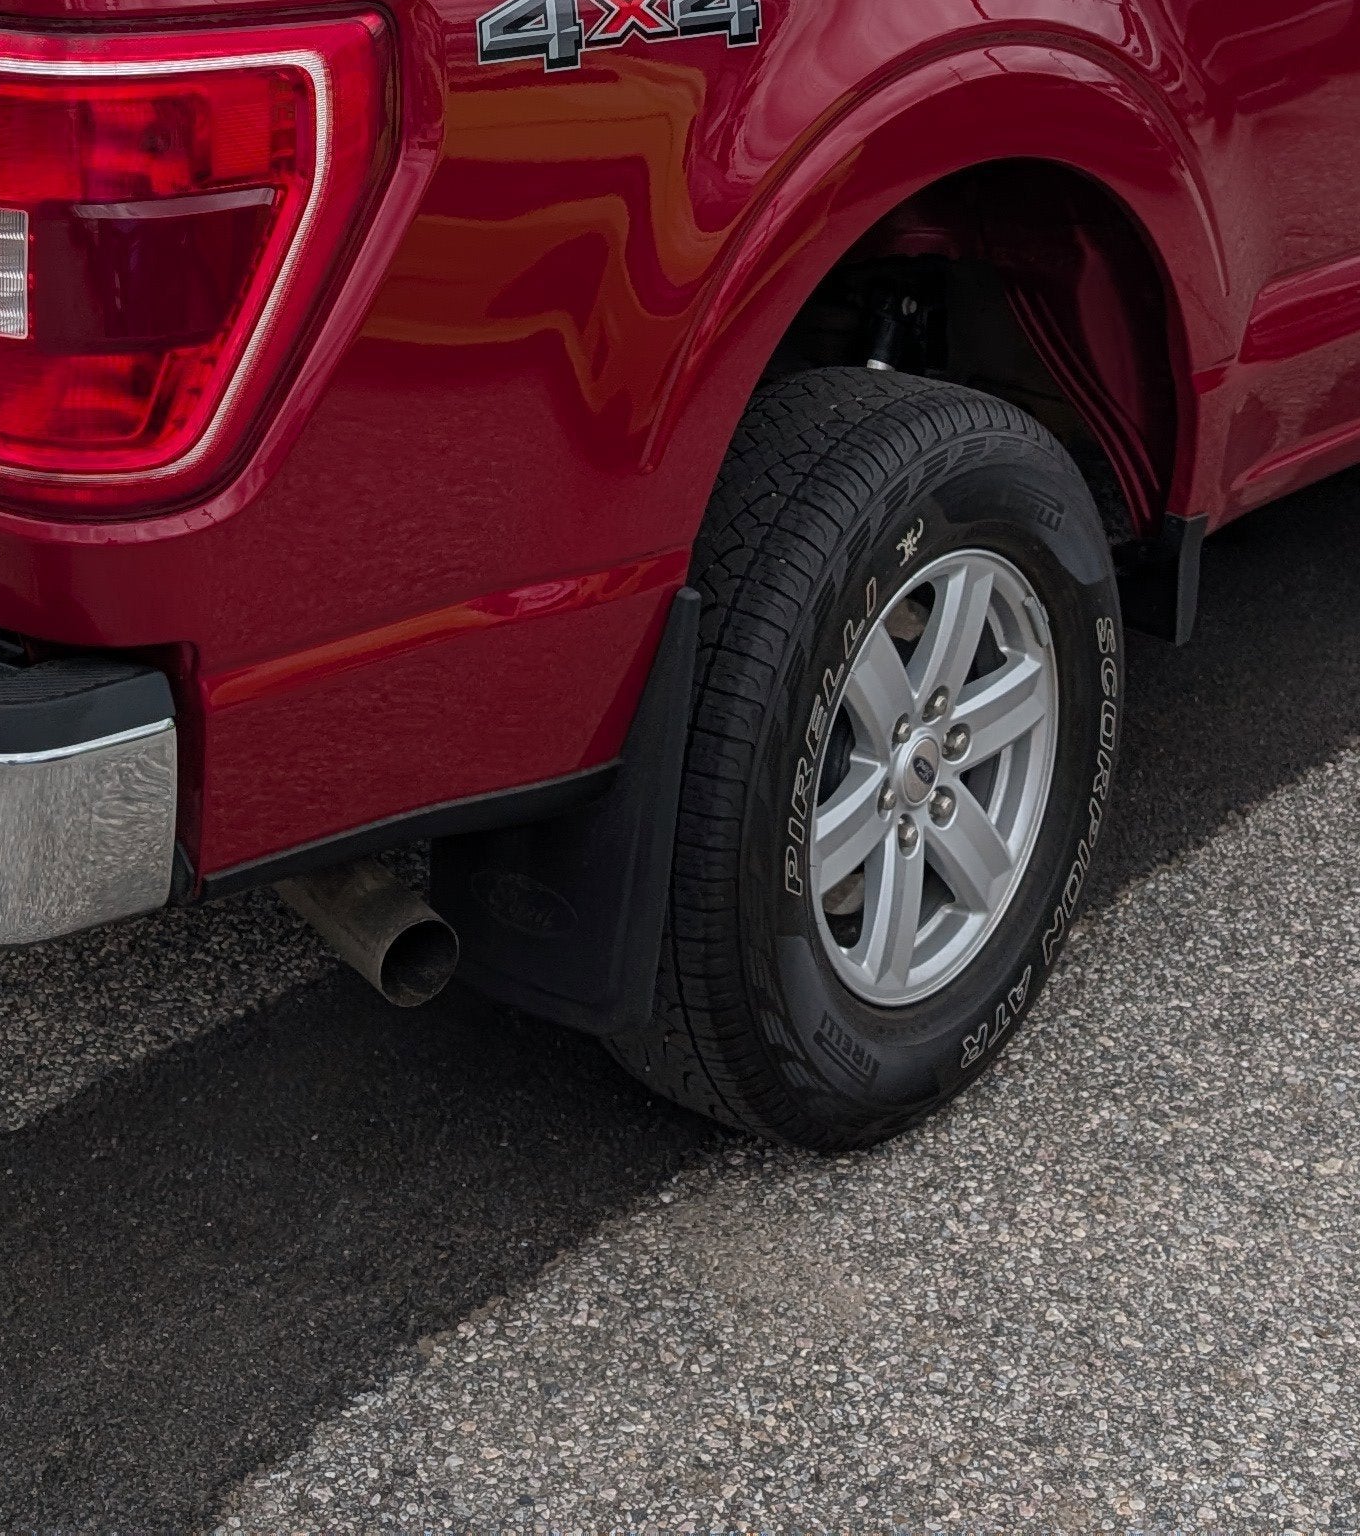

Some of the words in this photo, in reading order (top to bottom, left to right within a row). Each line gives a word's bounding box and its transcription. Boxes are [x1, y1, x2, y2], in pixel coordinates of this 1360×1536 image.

[785, 576, 878, 897] PIRELLI
[1042, 616, 1118, 965] SCORPION
[960, 964, 1033, 1069] ATR
